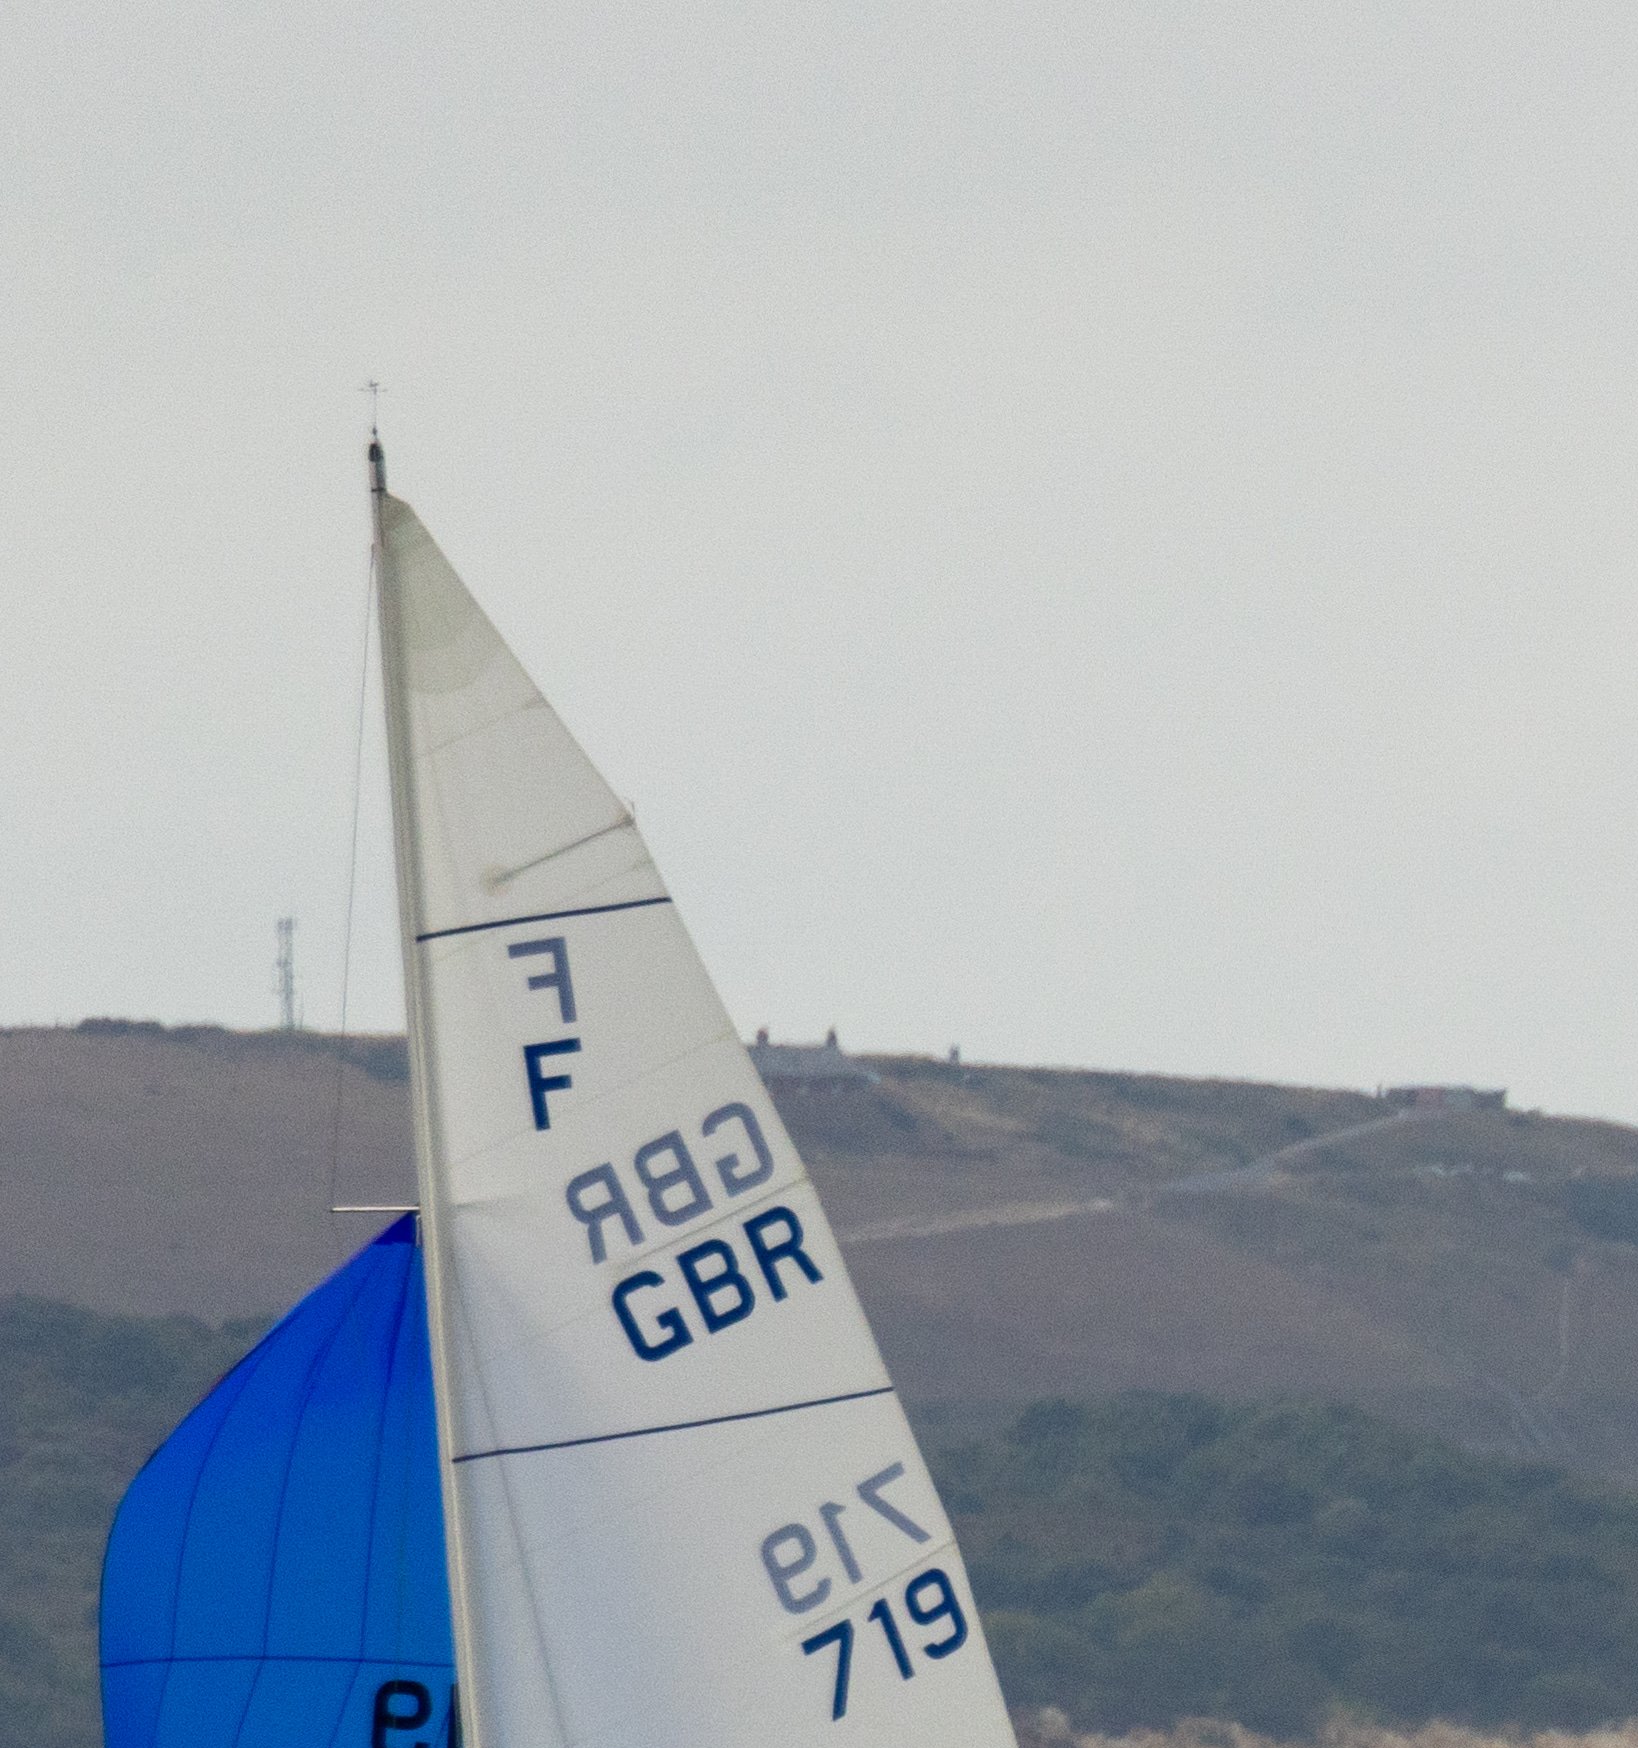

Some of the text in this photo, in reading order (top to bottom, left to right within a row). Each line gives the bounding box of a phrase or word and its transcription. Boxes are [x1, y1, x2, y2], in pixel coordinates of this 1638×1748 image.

[523, 1039, 582, 1130] F
[611, 1205, 824, 1362] GBR
[801, 1569, 969, 1722] 719
